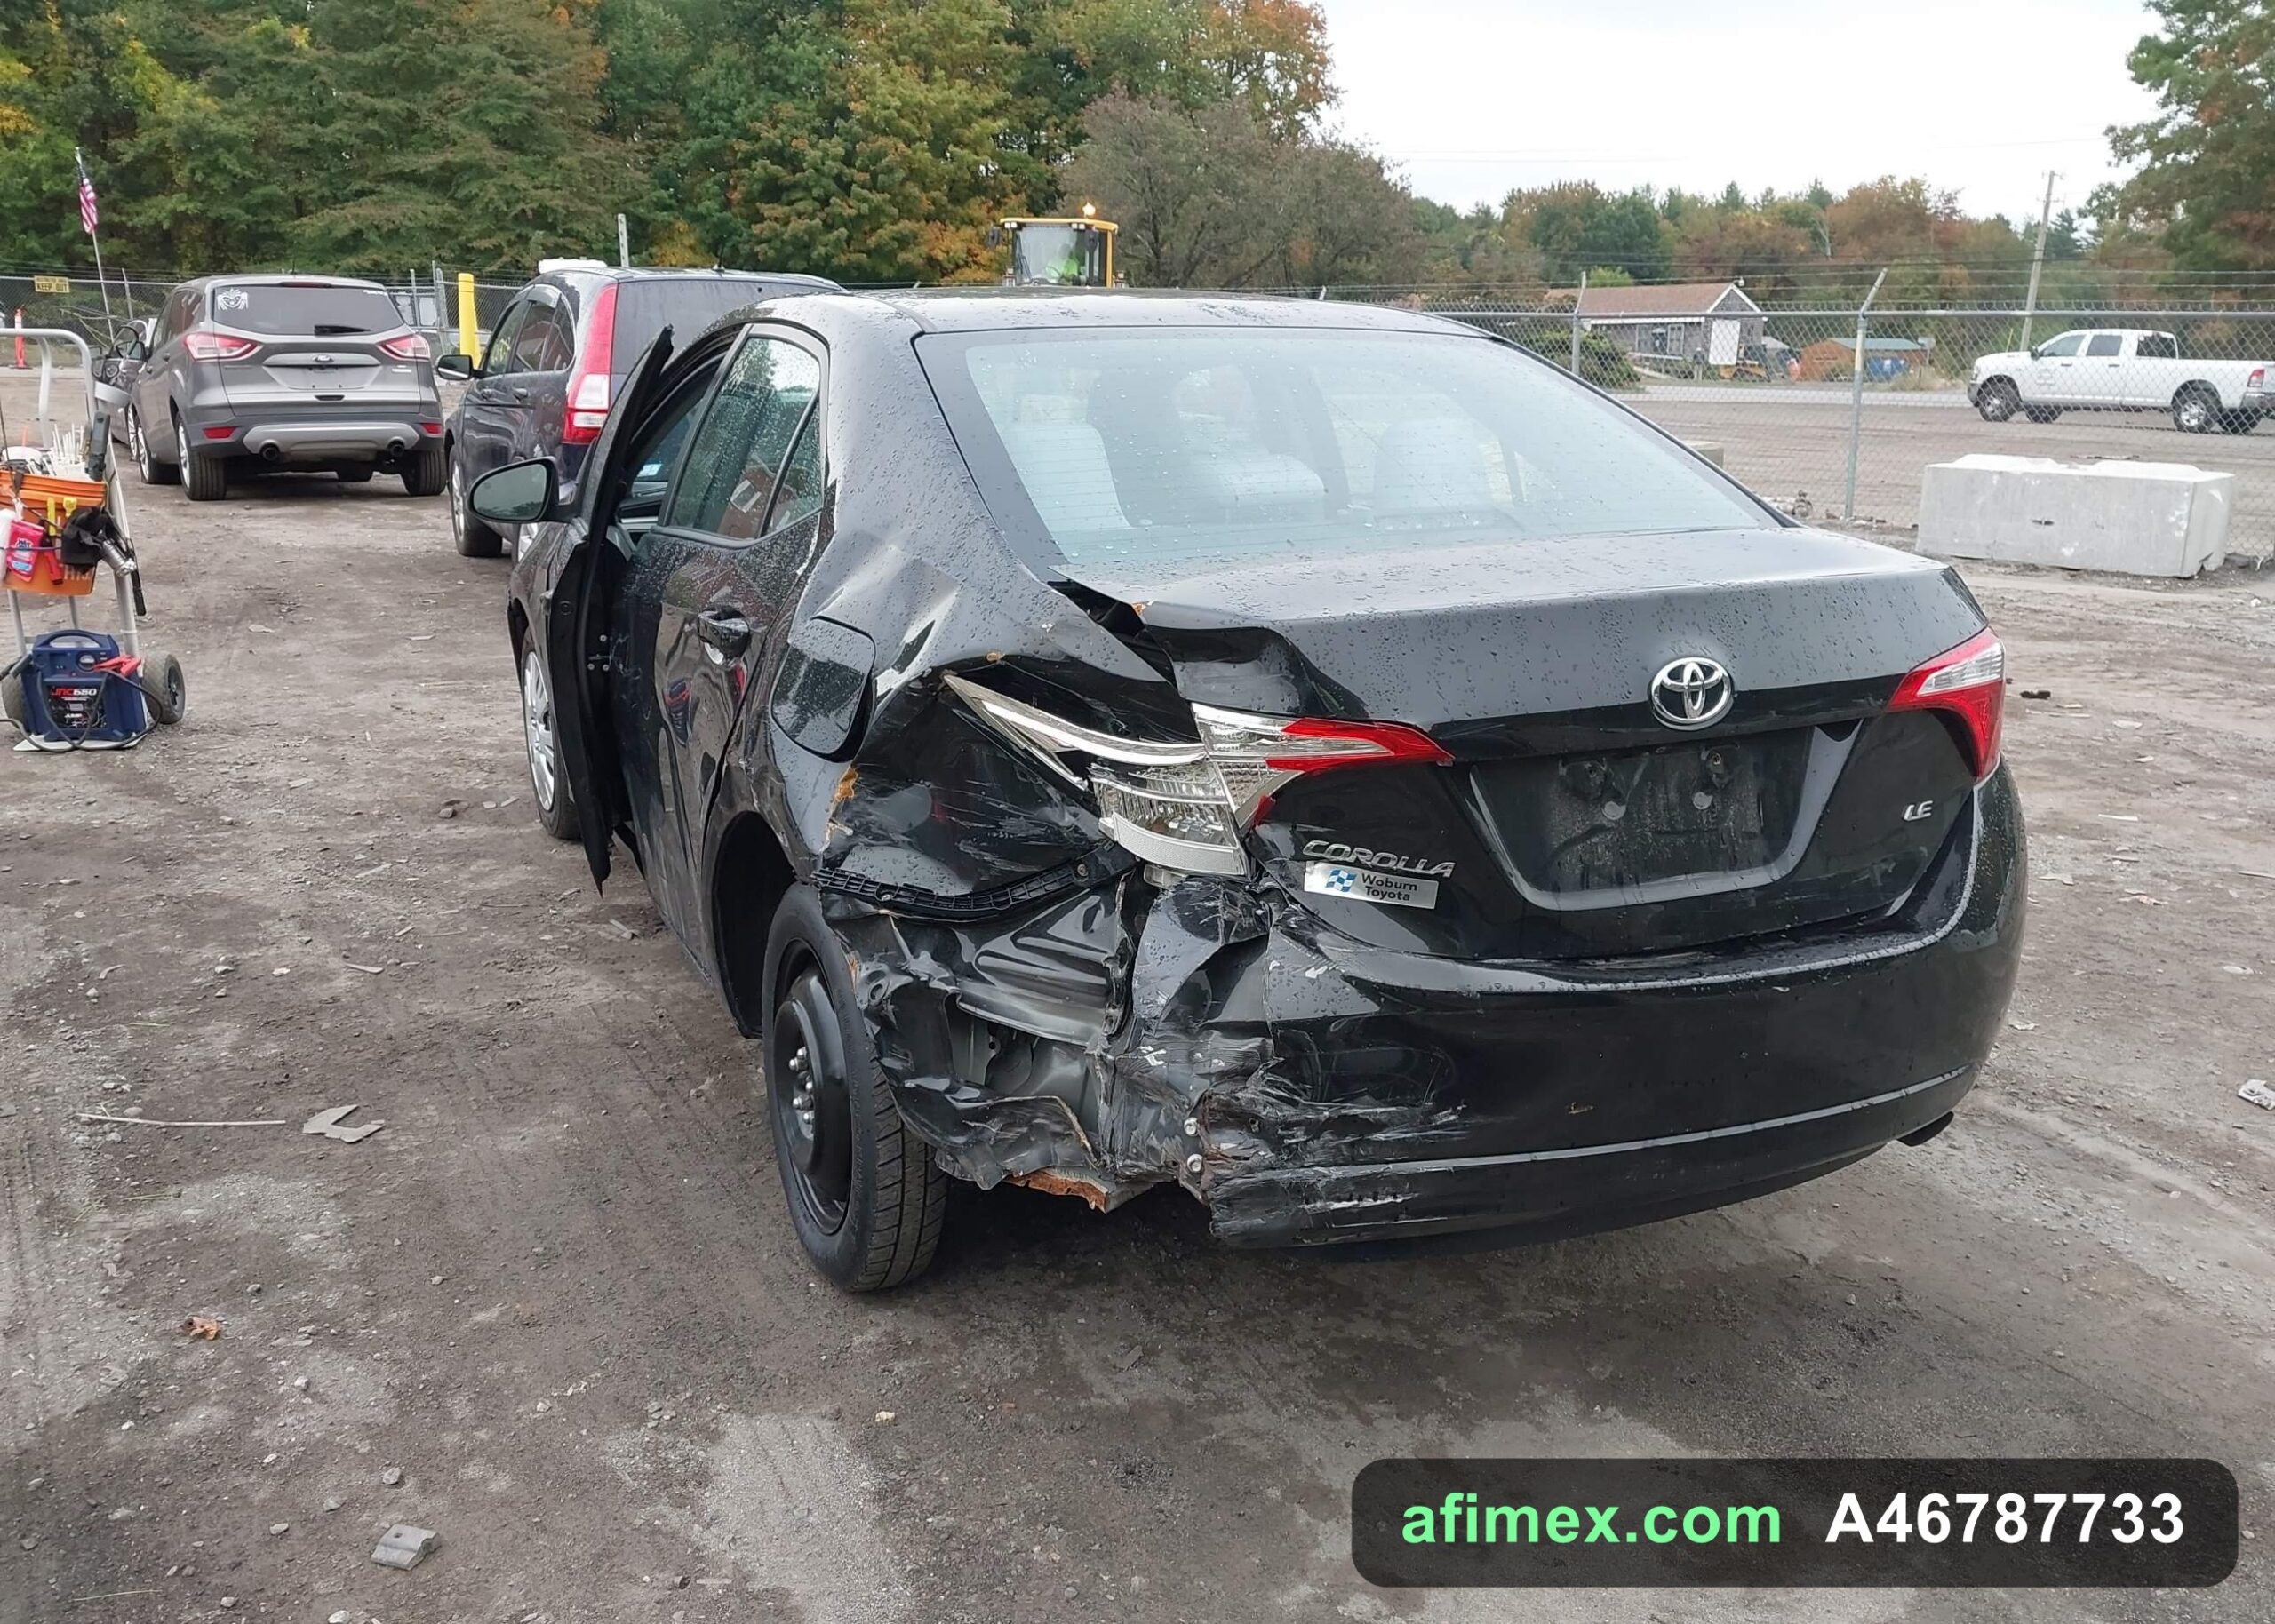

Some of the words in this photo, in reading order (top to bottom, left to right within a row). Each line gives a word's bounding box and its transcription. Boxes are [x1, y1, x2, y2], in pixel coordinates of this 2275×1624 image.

[1904, 800, 1933, 821] LE
[1302, 840, 1456, 878] COROLLA
[1361, 872, 1417, 891] Woburn
[1365, 885, 1410, 901] Toyota
